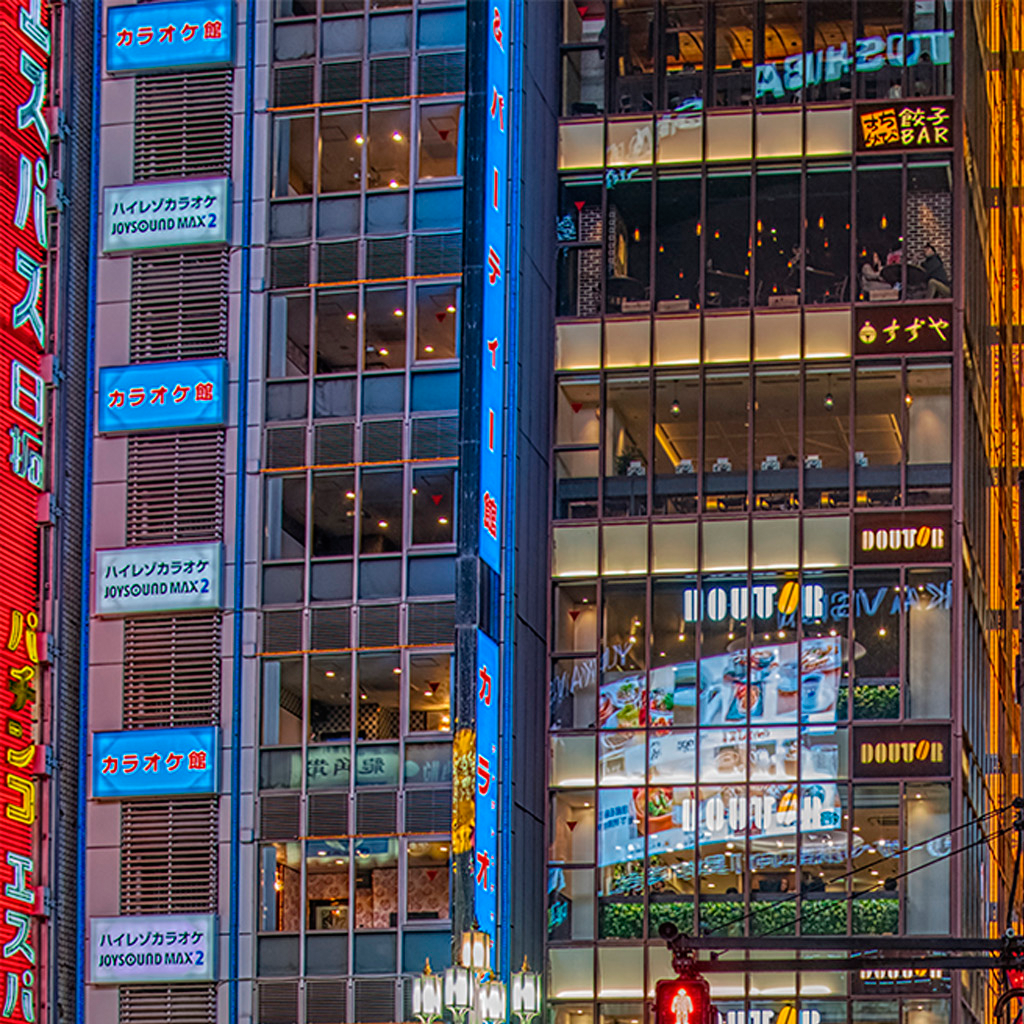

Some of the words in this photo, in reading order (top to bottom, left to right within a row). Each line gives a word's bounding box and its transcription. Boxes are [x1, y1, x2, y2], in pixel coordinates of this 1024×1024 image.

[116, 20, 223, 48] カラオケ館
[898, 106, 949, 127] 餃子
[901, 127, 949, 145] BAR
[111, 194, 218, 215] ハイレゾカラオケ
[110, 217, 175, 236] JOYSOUND
[882, 316, 950, 344] すずや
[107, 381, 215, 410] カラオケ館
[861, 526, 945, 552] DOUTOR
[105, 559, 209, 579] ハイレゾカラオケ
[104, 582, 168, 599] JOYSOUND
[684, 580, 824, 622] DOUTOR
[5, 611, 38, 825] パチンコ
[102, 750, 208, 776] カラオケ館
[860, 740, 944, 766] DOUTOR
[99, 932, 206, 950] ハイレゾカラオケ
[98, 951, 163, 968] JOYSOUND
